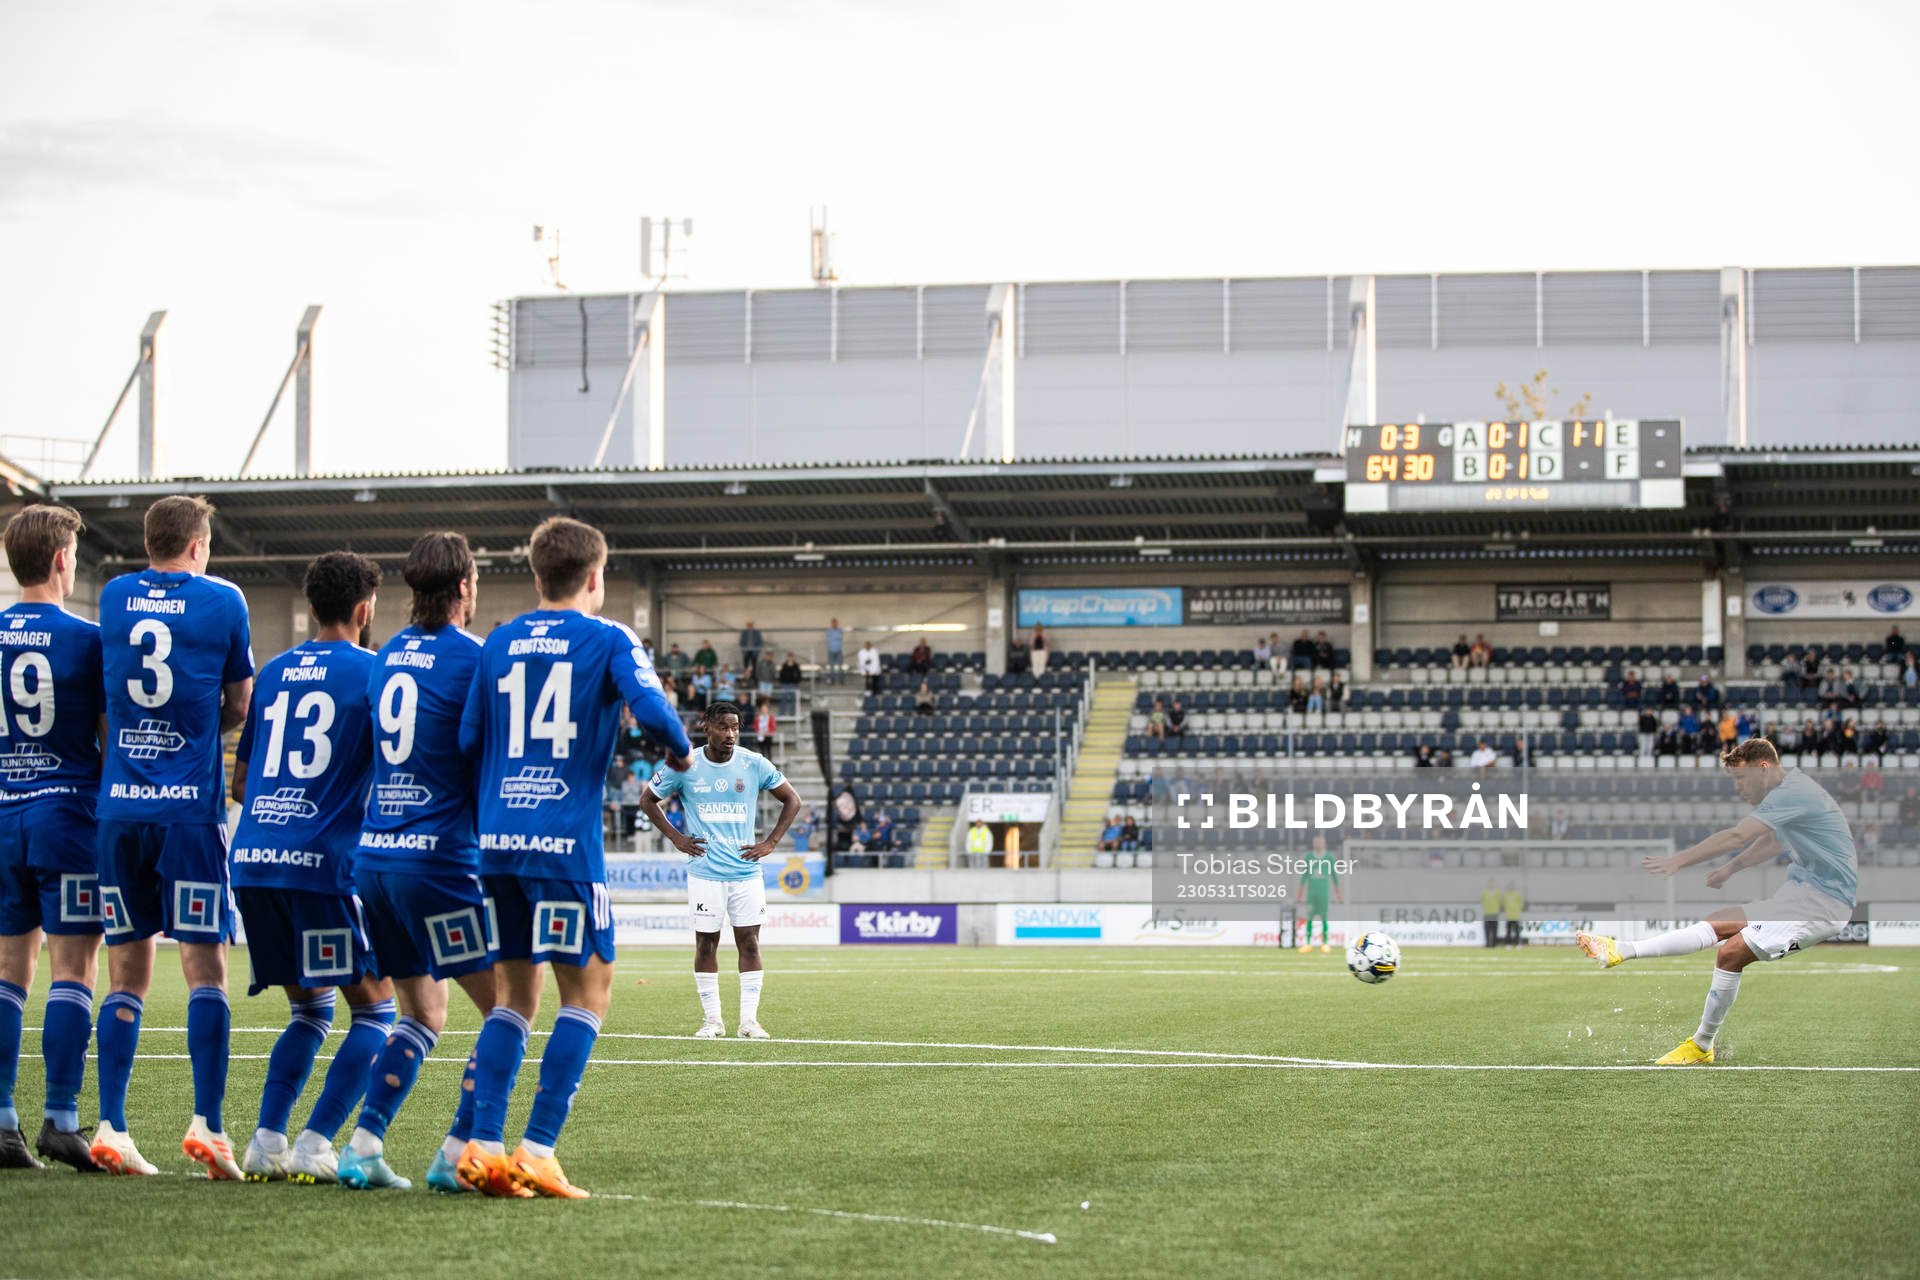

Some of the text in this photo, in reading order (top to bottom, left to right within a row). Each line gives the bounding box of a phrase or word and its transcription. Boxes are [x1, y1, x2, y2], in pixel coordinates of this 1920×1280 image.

[1346, 428, 1362, 448] H
[1462, 428, 1478, 446] A
[1539, 426, 1553, 446] C
[1616, 425, 1628, 445] E
[1463, 457, 1477, 476] B
[1538, 456, 1554, 475] D
[1616, 454, 1628, 474] F
[127, 597, 185, 614] LUNDGREN
[127, 619, 173, 708] 3
[282, 667, 327, 682] PICHKAH
[379, 672, 418, 766] 9
[498, 661, 577, 759] 14
[125, 734, 176, 747] SUNDFRAKT
[263, 691, 336, 779] 13
[111, 783, 198, 800] BILBOLAGET
[698, 803, 746, 813] SANDVIK
[360, 832, 439, 851] BILBOLAGET
[480, 833, 576, 855] BILBOLAGET
[234, 848, 324, 868] BILBOLAGET
[1015, 908, 1101, 924] SANDVIK
[1380, 908, 1477, 924] ERSAND
